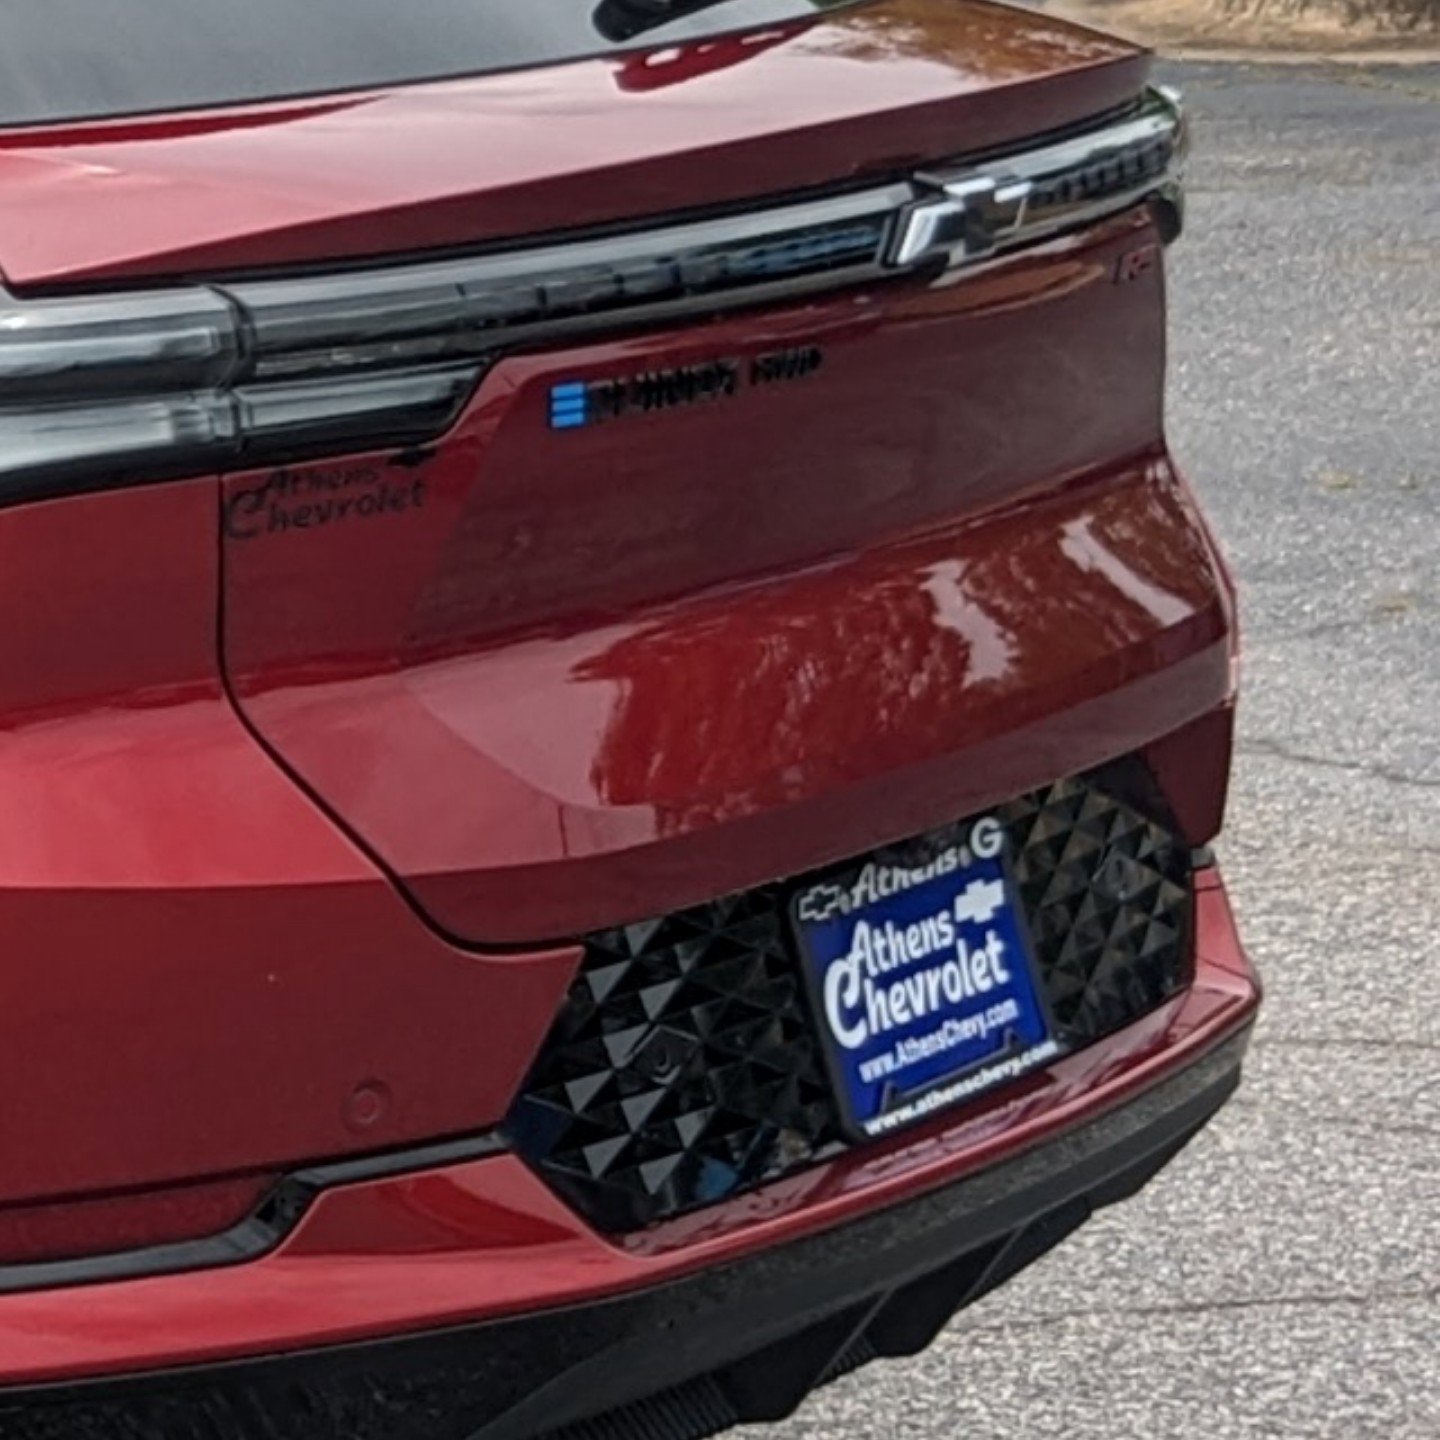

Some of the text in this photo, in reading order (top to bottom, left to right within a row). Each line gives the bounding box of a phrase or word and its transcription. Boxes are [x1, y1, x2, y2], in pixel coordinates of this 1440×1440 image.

[225, 479, 426, 539] Chevrolet
[847, 910, 956, 976] Athens
[824, 929, 1010, 1048] Chevrolet
[859, 998, 1019, 1083] www.AthensChevy.com
[864, 1041, 1058, 1135] www.athenschevy.com
